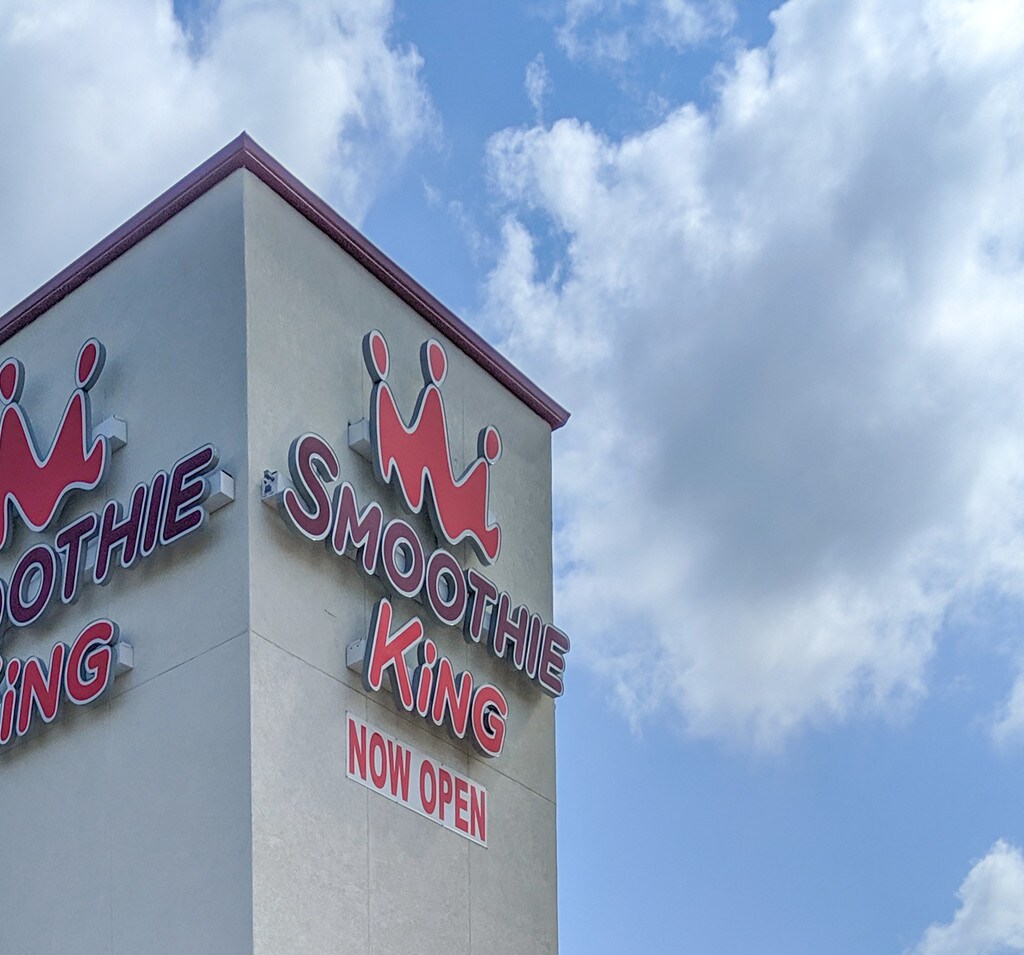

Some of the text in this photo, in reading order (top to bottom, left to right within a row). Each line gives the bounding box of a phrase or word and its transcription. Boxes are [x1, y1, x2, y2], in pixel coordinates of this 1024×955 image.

[283, 432, 571, 698] SMOOTHIE
[348, 716, 486, 844] NOW OPEN
